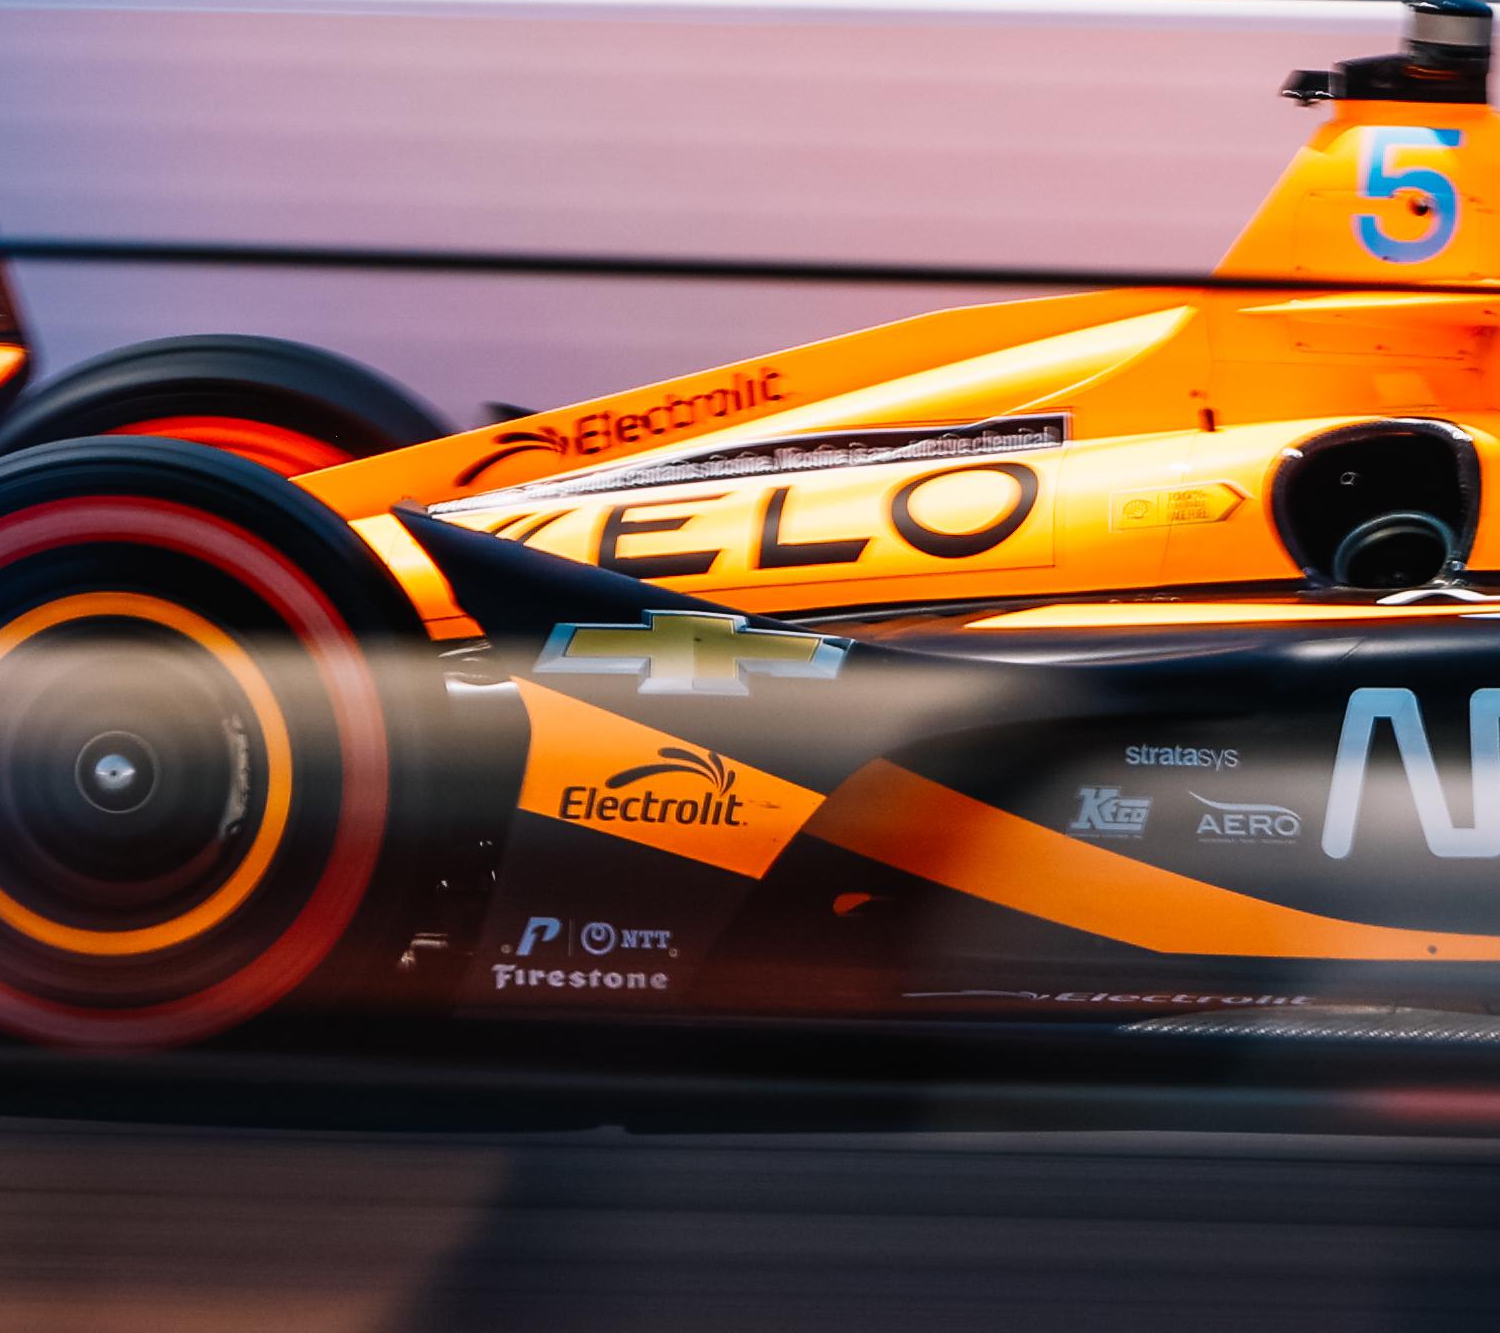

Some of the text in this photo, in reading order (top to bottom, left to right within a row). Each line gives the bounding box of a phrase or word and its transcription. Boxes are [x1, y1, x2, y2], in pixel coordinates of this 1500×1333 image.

[1352, 125, 1462, 264] 5
[576, 366, 786, 455] Electrolit
[1125, 744, 1239, 770] stratasys
[559, 786, 744, 826] Electrolit
[1196, 813, 1300, 836] AERO
[620, 930, 671, 949] NTT
[491, 964, 669, 989] Firestone
